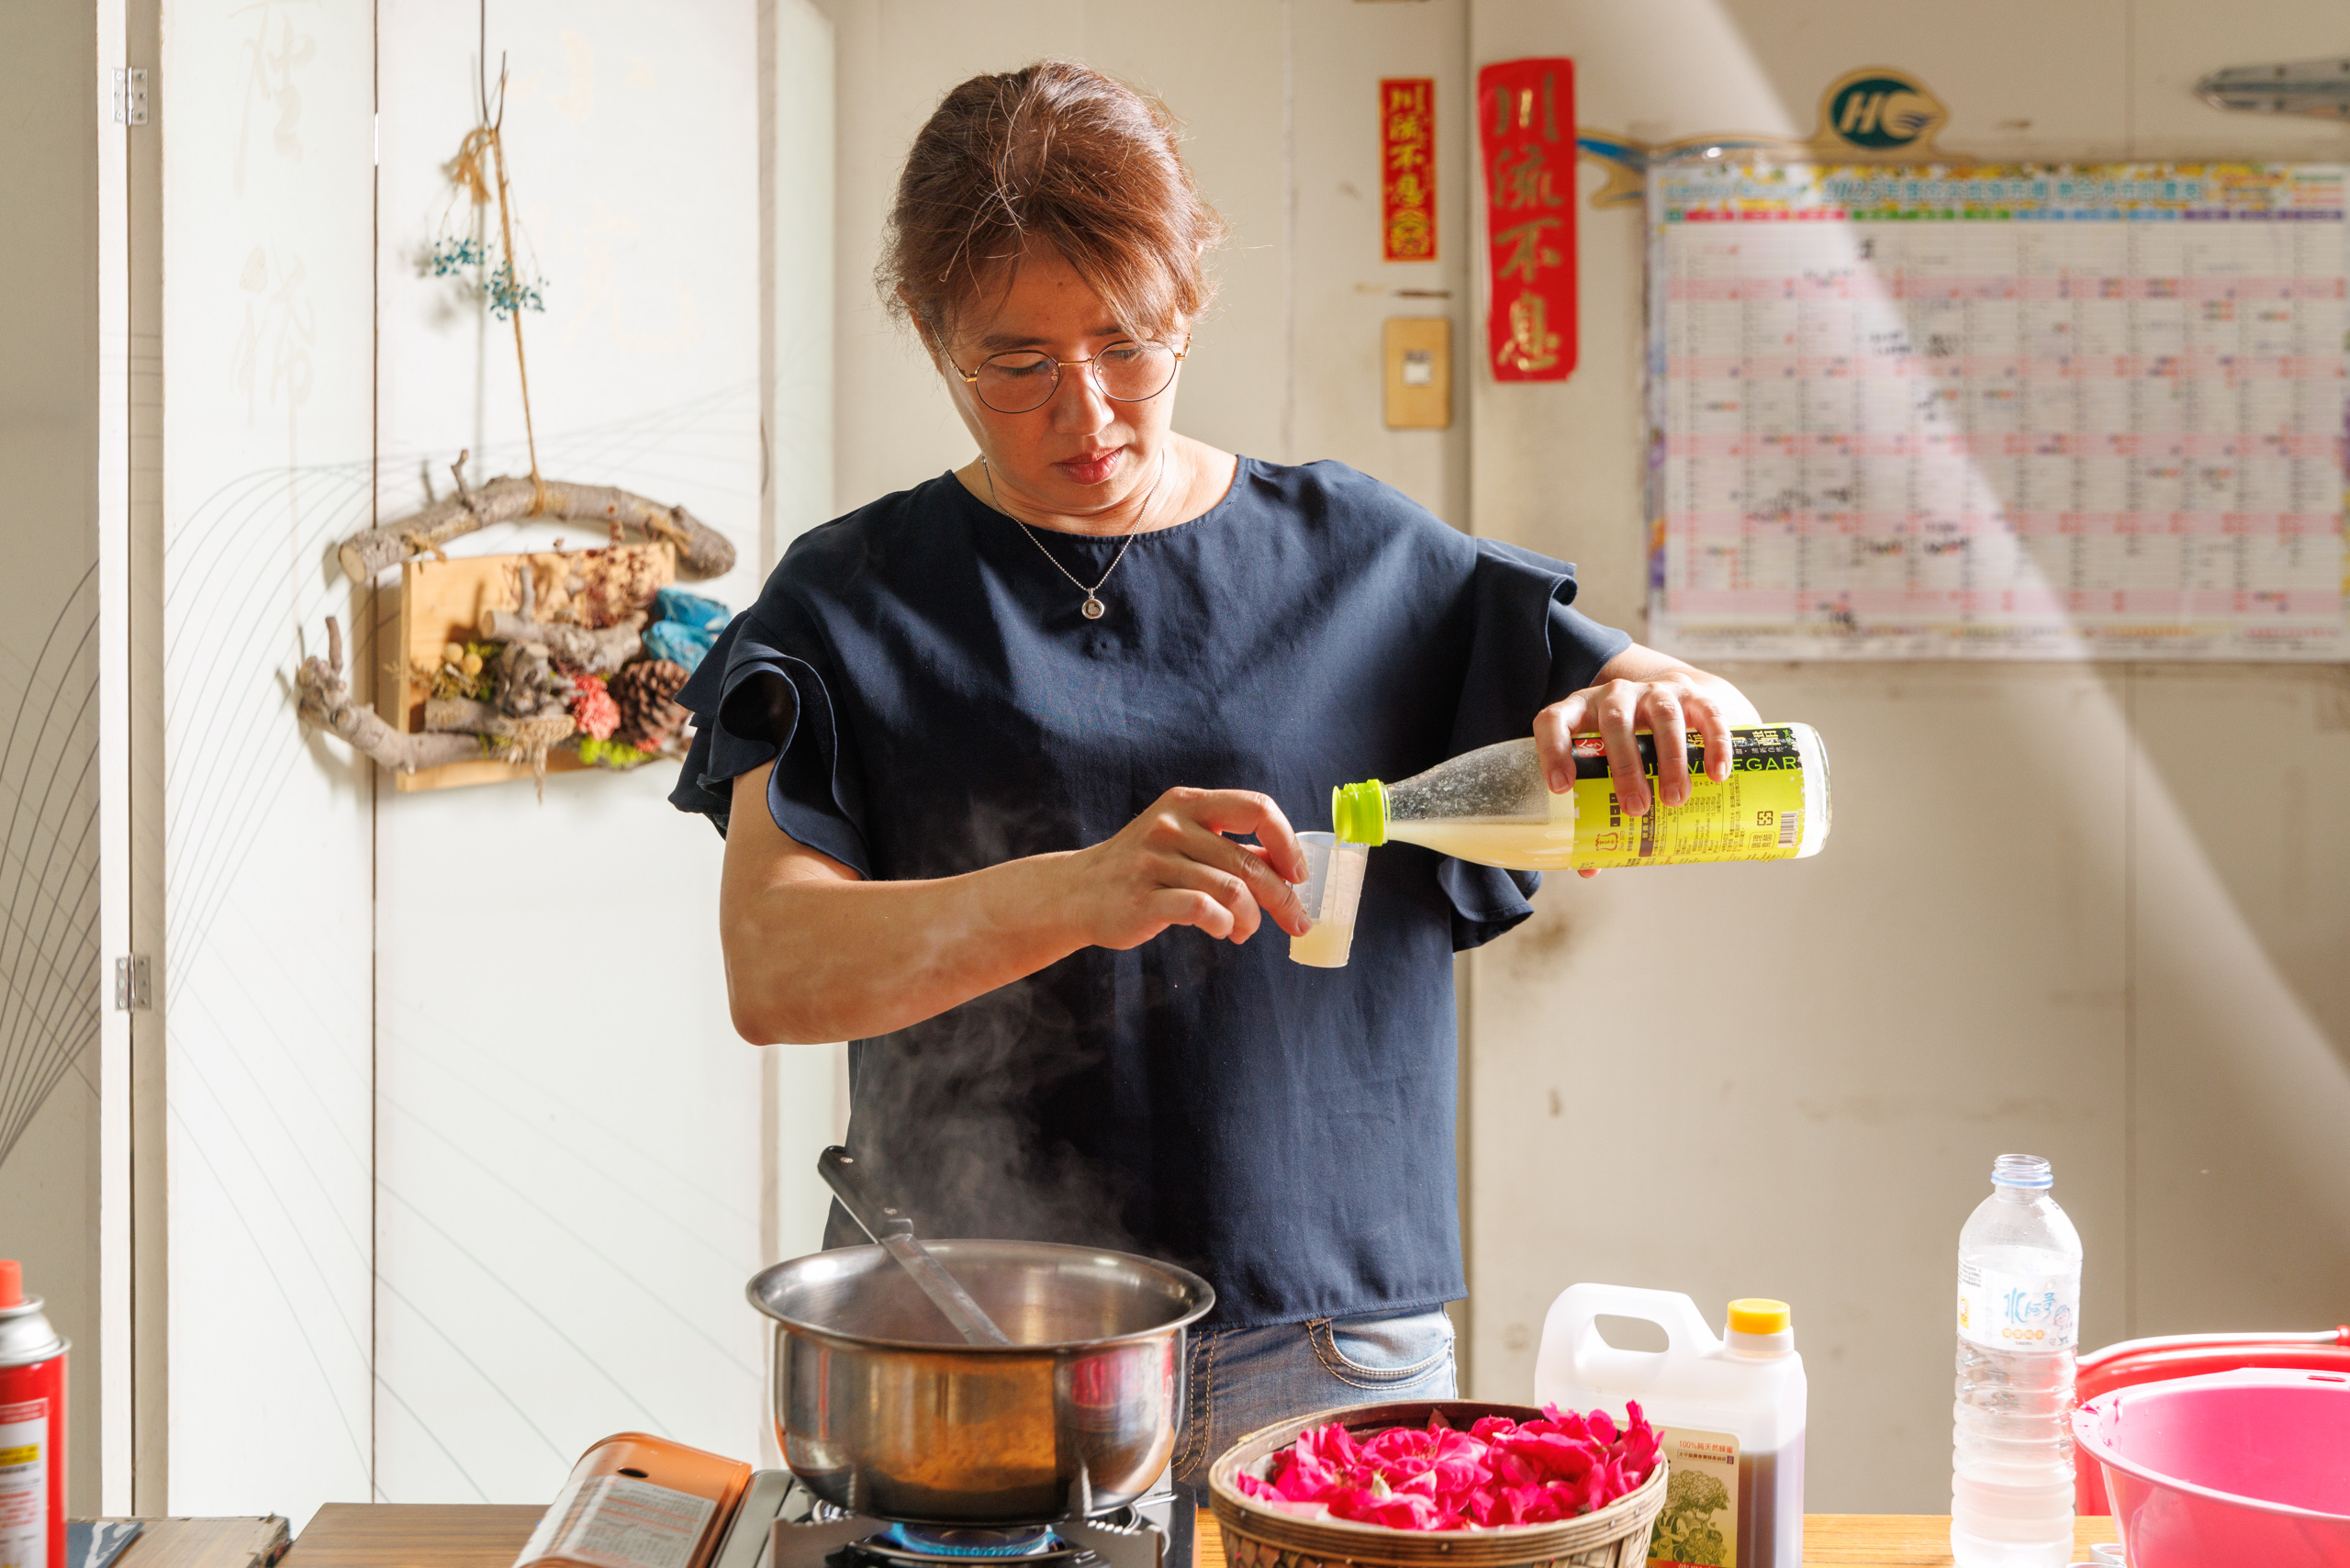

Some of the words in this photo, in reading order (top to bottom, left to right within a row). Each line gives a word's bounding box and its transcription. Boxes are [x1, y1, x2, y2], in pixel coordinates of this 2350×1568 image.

[1490, 71, 1564, 373] 川流不息
[1687, 756, 1797, 775] VIEGAR
